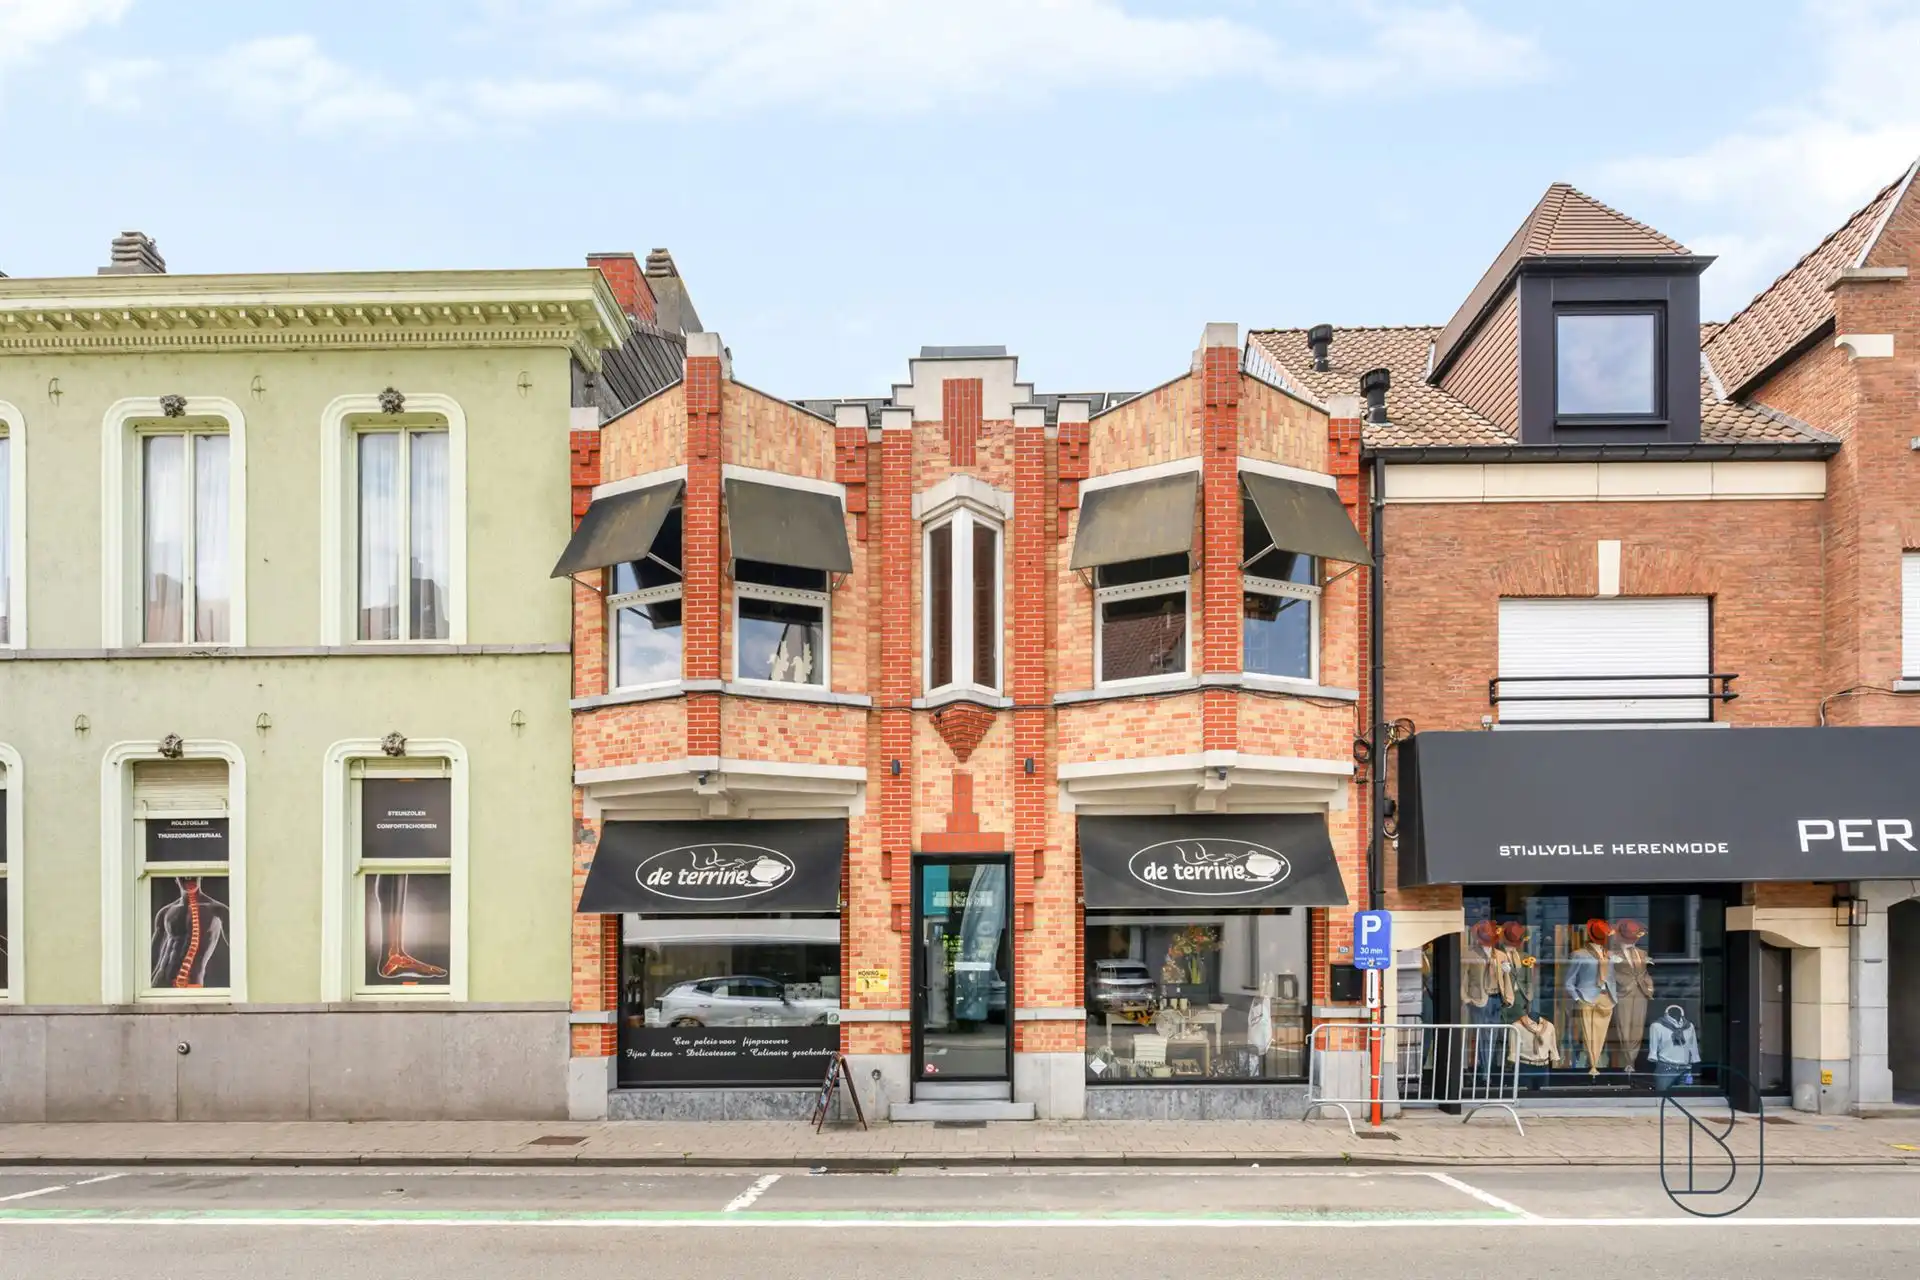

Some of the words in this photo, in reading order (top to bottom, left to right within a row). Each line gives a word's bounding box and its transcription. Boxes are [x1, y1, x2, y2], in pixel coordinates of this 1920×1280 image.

[1798, 819, 1918, 852] PER
[1499, 844, 1604, 856] STIJLVOLLE
[1612, 842, 1729, 855] HERENMODE
[646, 867, 673, 886] de
[677, 867, 749, 886] terrine
[1143, 862, 1168, 880] de
[1173, 862, 1245, 880] terrine
[1361, 915, 1382, 945] P
[673, 1036, 690, 1045] Een
[651, 1048, 673, 1057] kazen
[686, 1048, 737, 1057] Delicatessen
[750, 1048, 789, 1056] Culinaire
